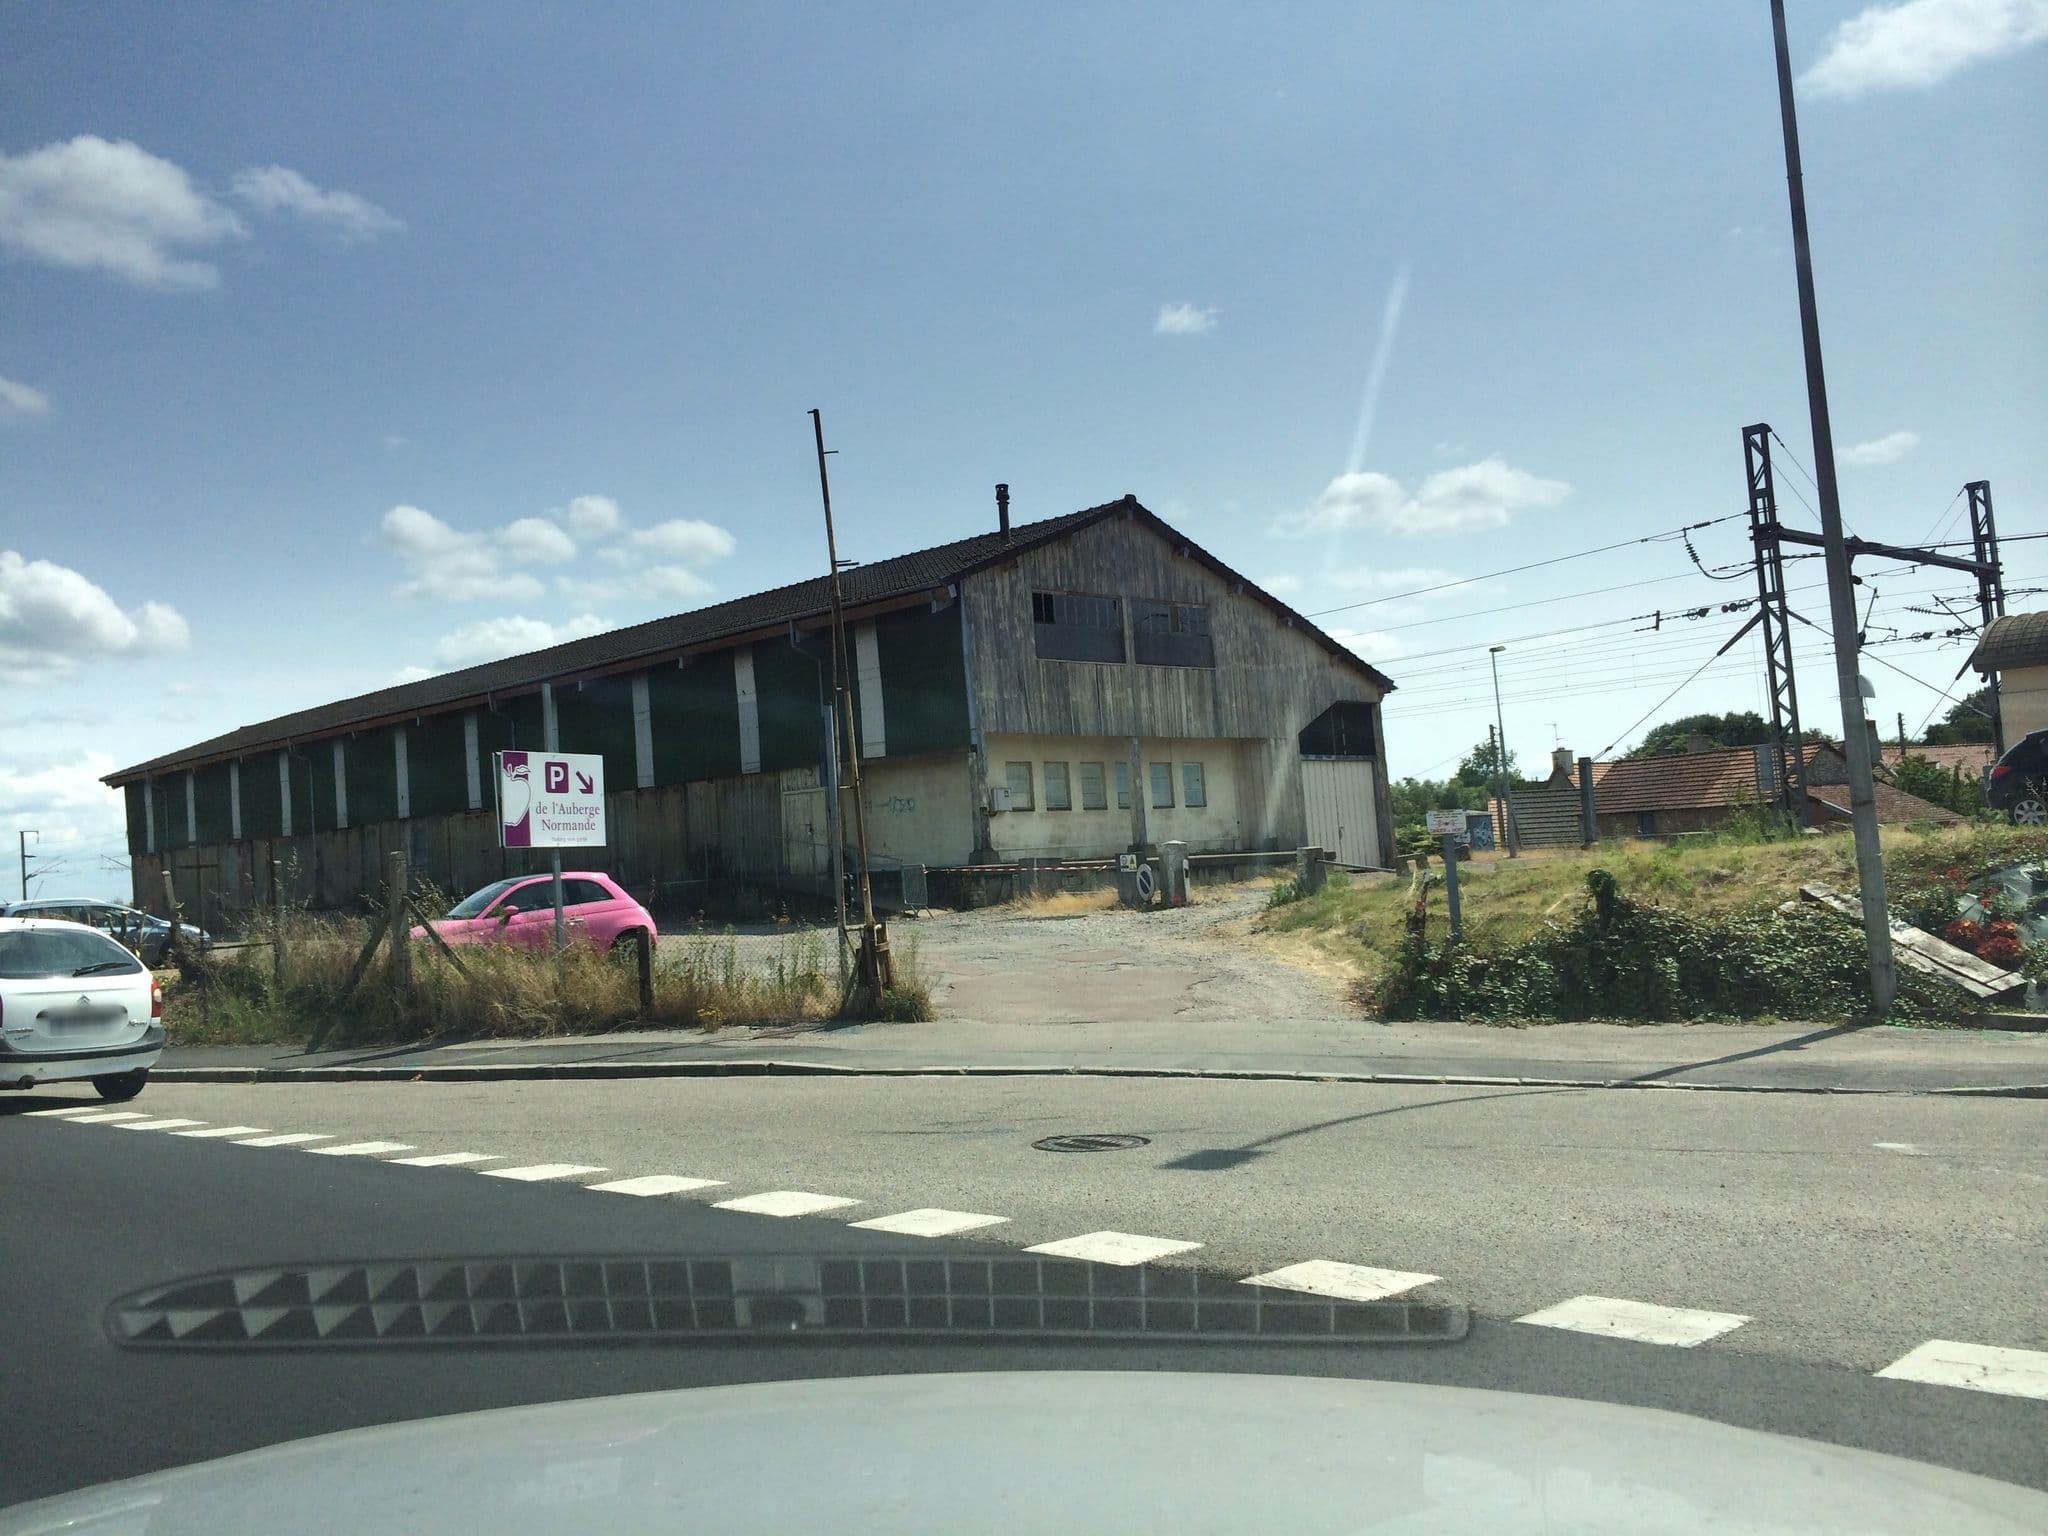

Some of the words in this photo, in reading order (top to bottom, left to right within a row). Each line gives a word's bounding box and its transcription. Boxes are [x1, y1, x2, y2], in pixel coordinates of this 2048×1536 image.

[550, 766, 565, 790] P
[535, 801, 548, 815] de
[552, 801, 600, 818] l'Auberge
[542, 819, 596, 831] Normande
